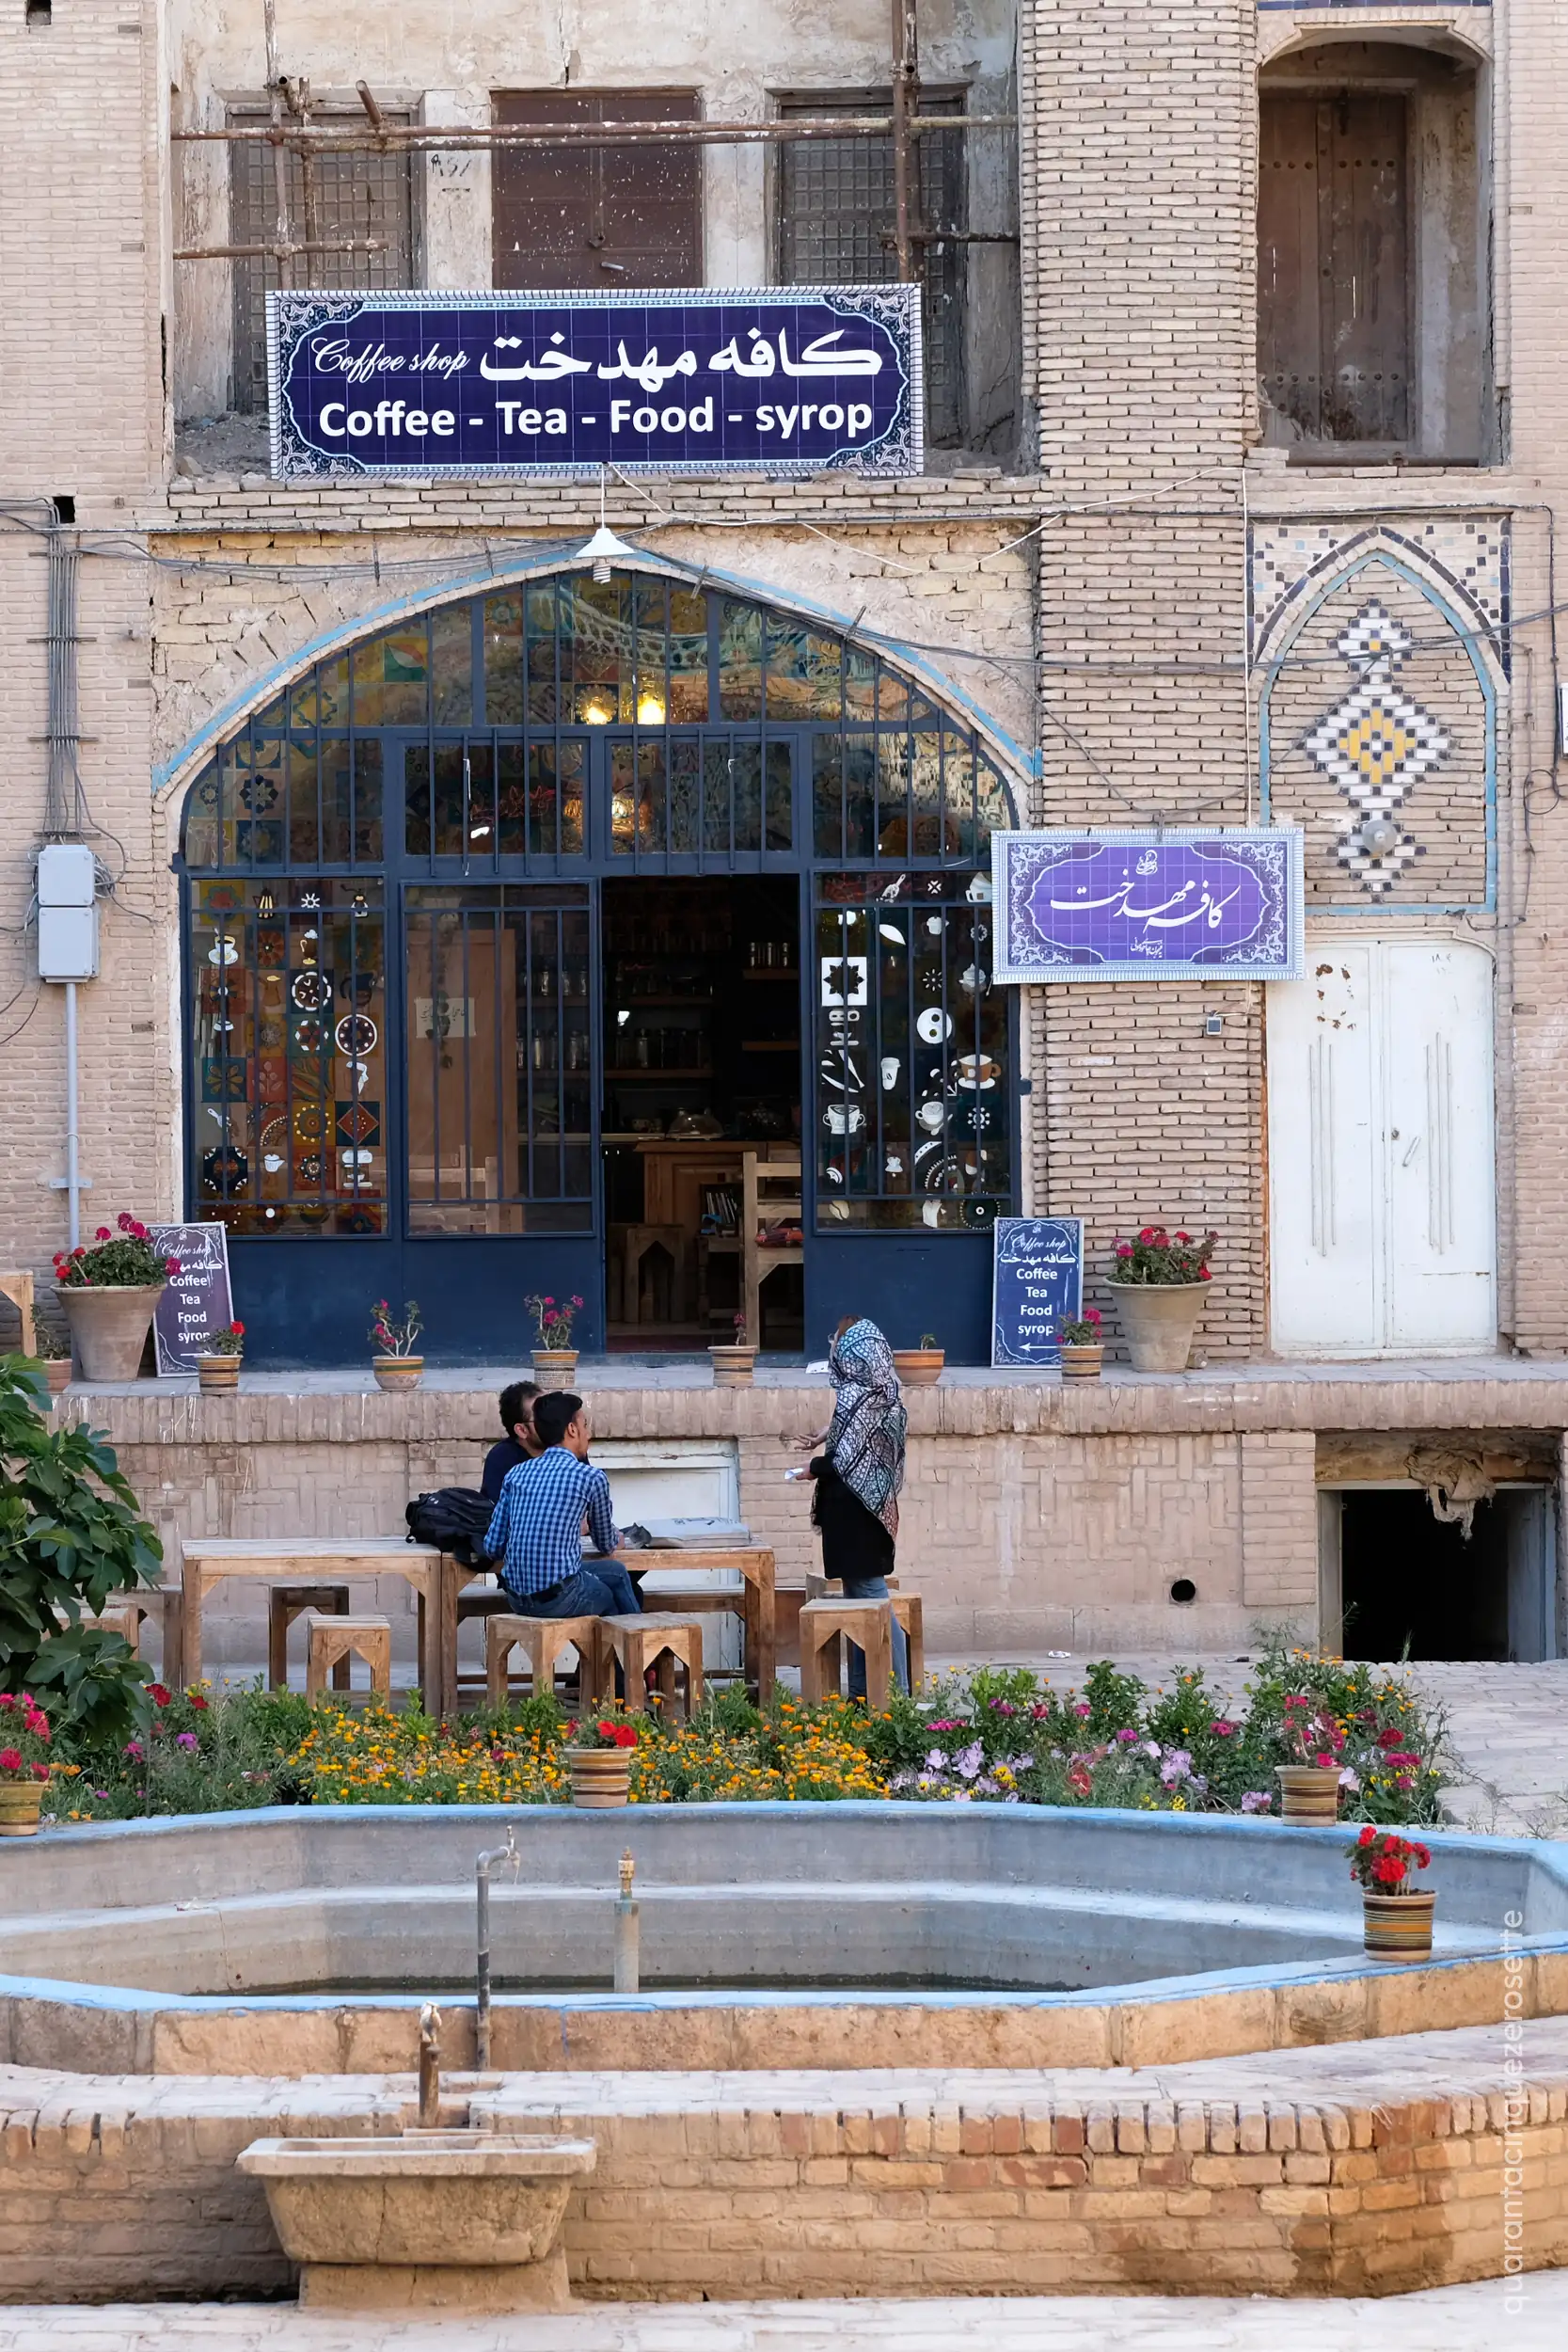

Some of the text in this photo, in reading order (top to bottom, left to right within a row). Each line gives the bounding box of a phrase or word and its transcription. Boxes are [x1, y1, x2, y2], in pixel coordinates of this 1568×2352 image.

[310, 337, 471, 384] Coffee shop
[479, 326, 884, 393] کافه مهدخت
[318, 400, 455, 437] Coffee
[495, 400, 568, 436] Tea
[610, 396, 713, 434] Food
[754, 399, 873, 439] syrop
[1142, 879, 1242, 933] کافه
[1010, 1233, 1067, 1252] Coffee shop
[159, 1242, 191, 1260] Coffee
[192, 1259, 223, 1270] کافه
[1000, 1252, 1076, 1266] کافه مهدخت
[169, 1274, 208, 1287] Coffee
[1016, 1268, 1058, 1280] Coffee
[1025, 1286, 1048, 1298] Tea
[179, 1293, 201, 1305] Tea
[1020, 1304, 1053, 1316] Food
[177, 1311, 208, 1323] Food
